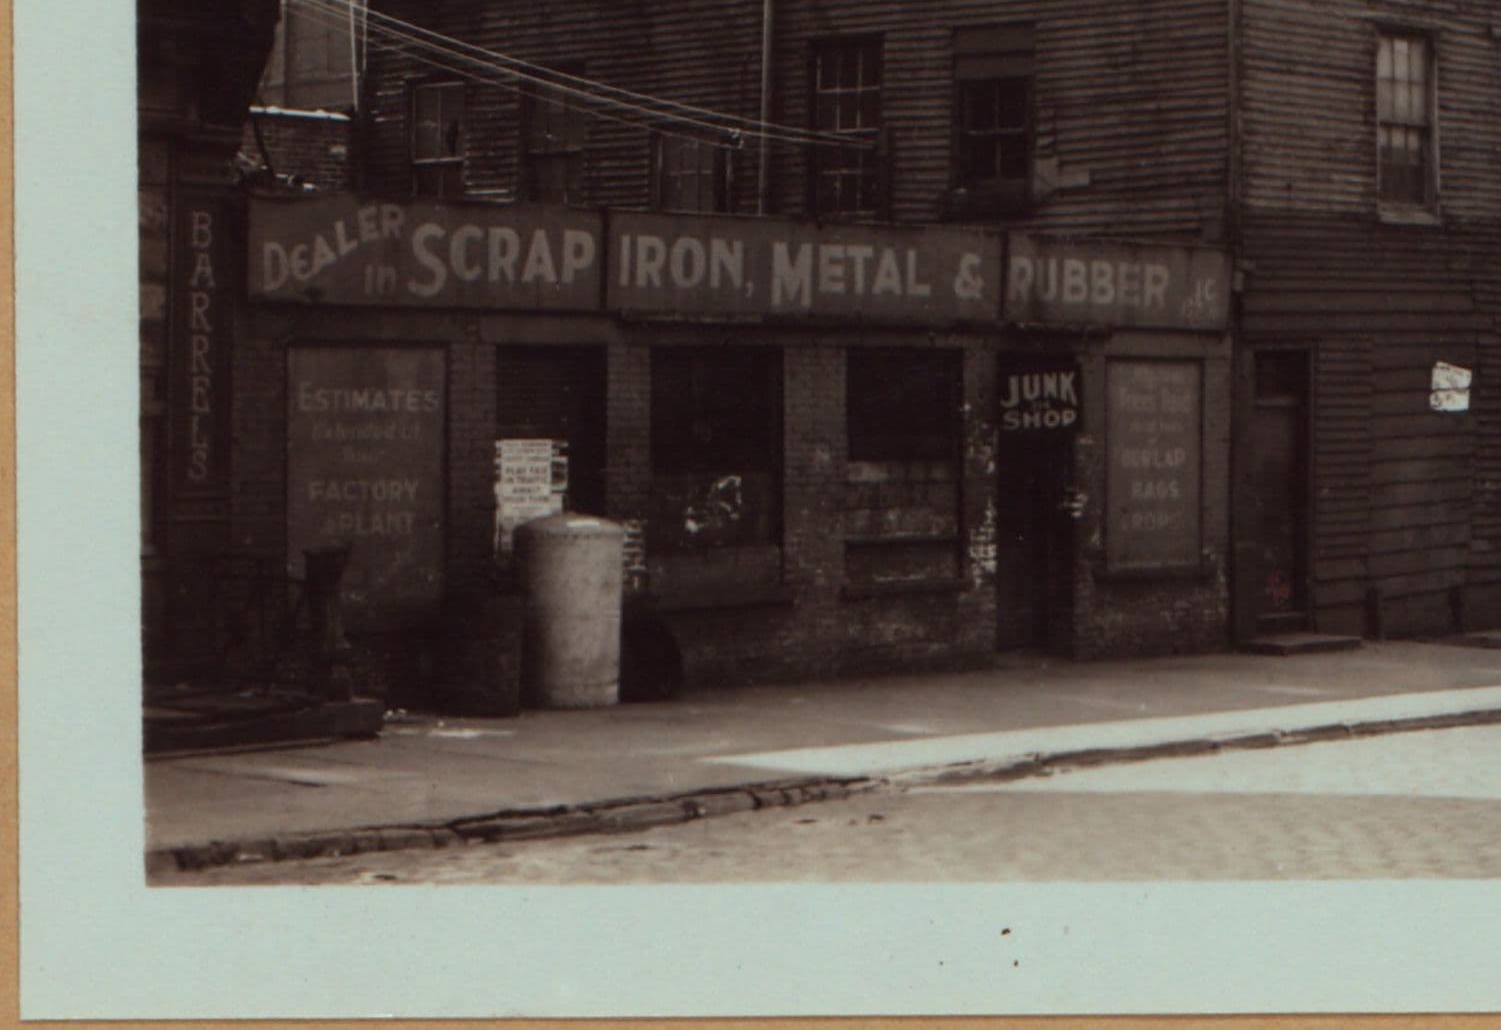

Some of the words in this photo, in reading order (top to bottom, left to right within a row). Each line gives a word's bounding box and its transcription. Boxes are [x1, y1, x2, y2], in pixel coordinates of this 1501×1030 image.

[264, 203, 407, 292] DEALER
[408, 223, 596, 297] SCRAP
[618, 234, 754, 299] IRON,
[771, 241, 930, 308] METAL
[954, 252, 985, 299] &
[1008, 253, 1170, 308] RUBBER
[189, 210, 217, 481] BARRELS
[299, 381, 440, 412] ESTIMATES
[1000, 371, 1078, 408] JUNK
[1002, 410, 1077, 431] SHOP
[1121, 447, 1187, 468] BURLAP
[308, 479, 420, 503] FACTORY
[338, 513, 418, 537] PLANT
